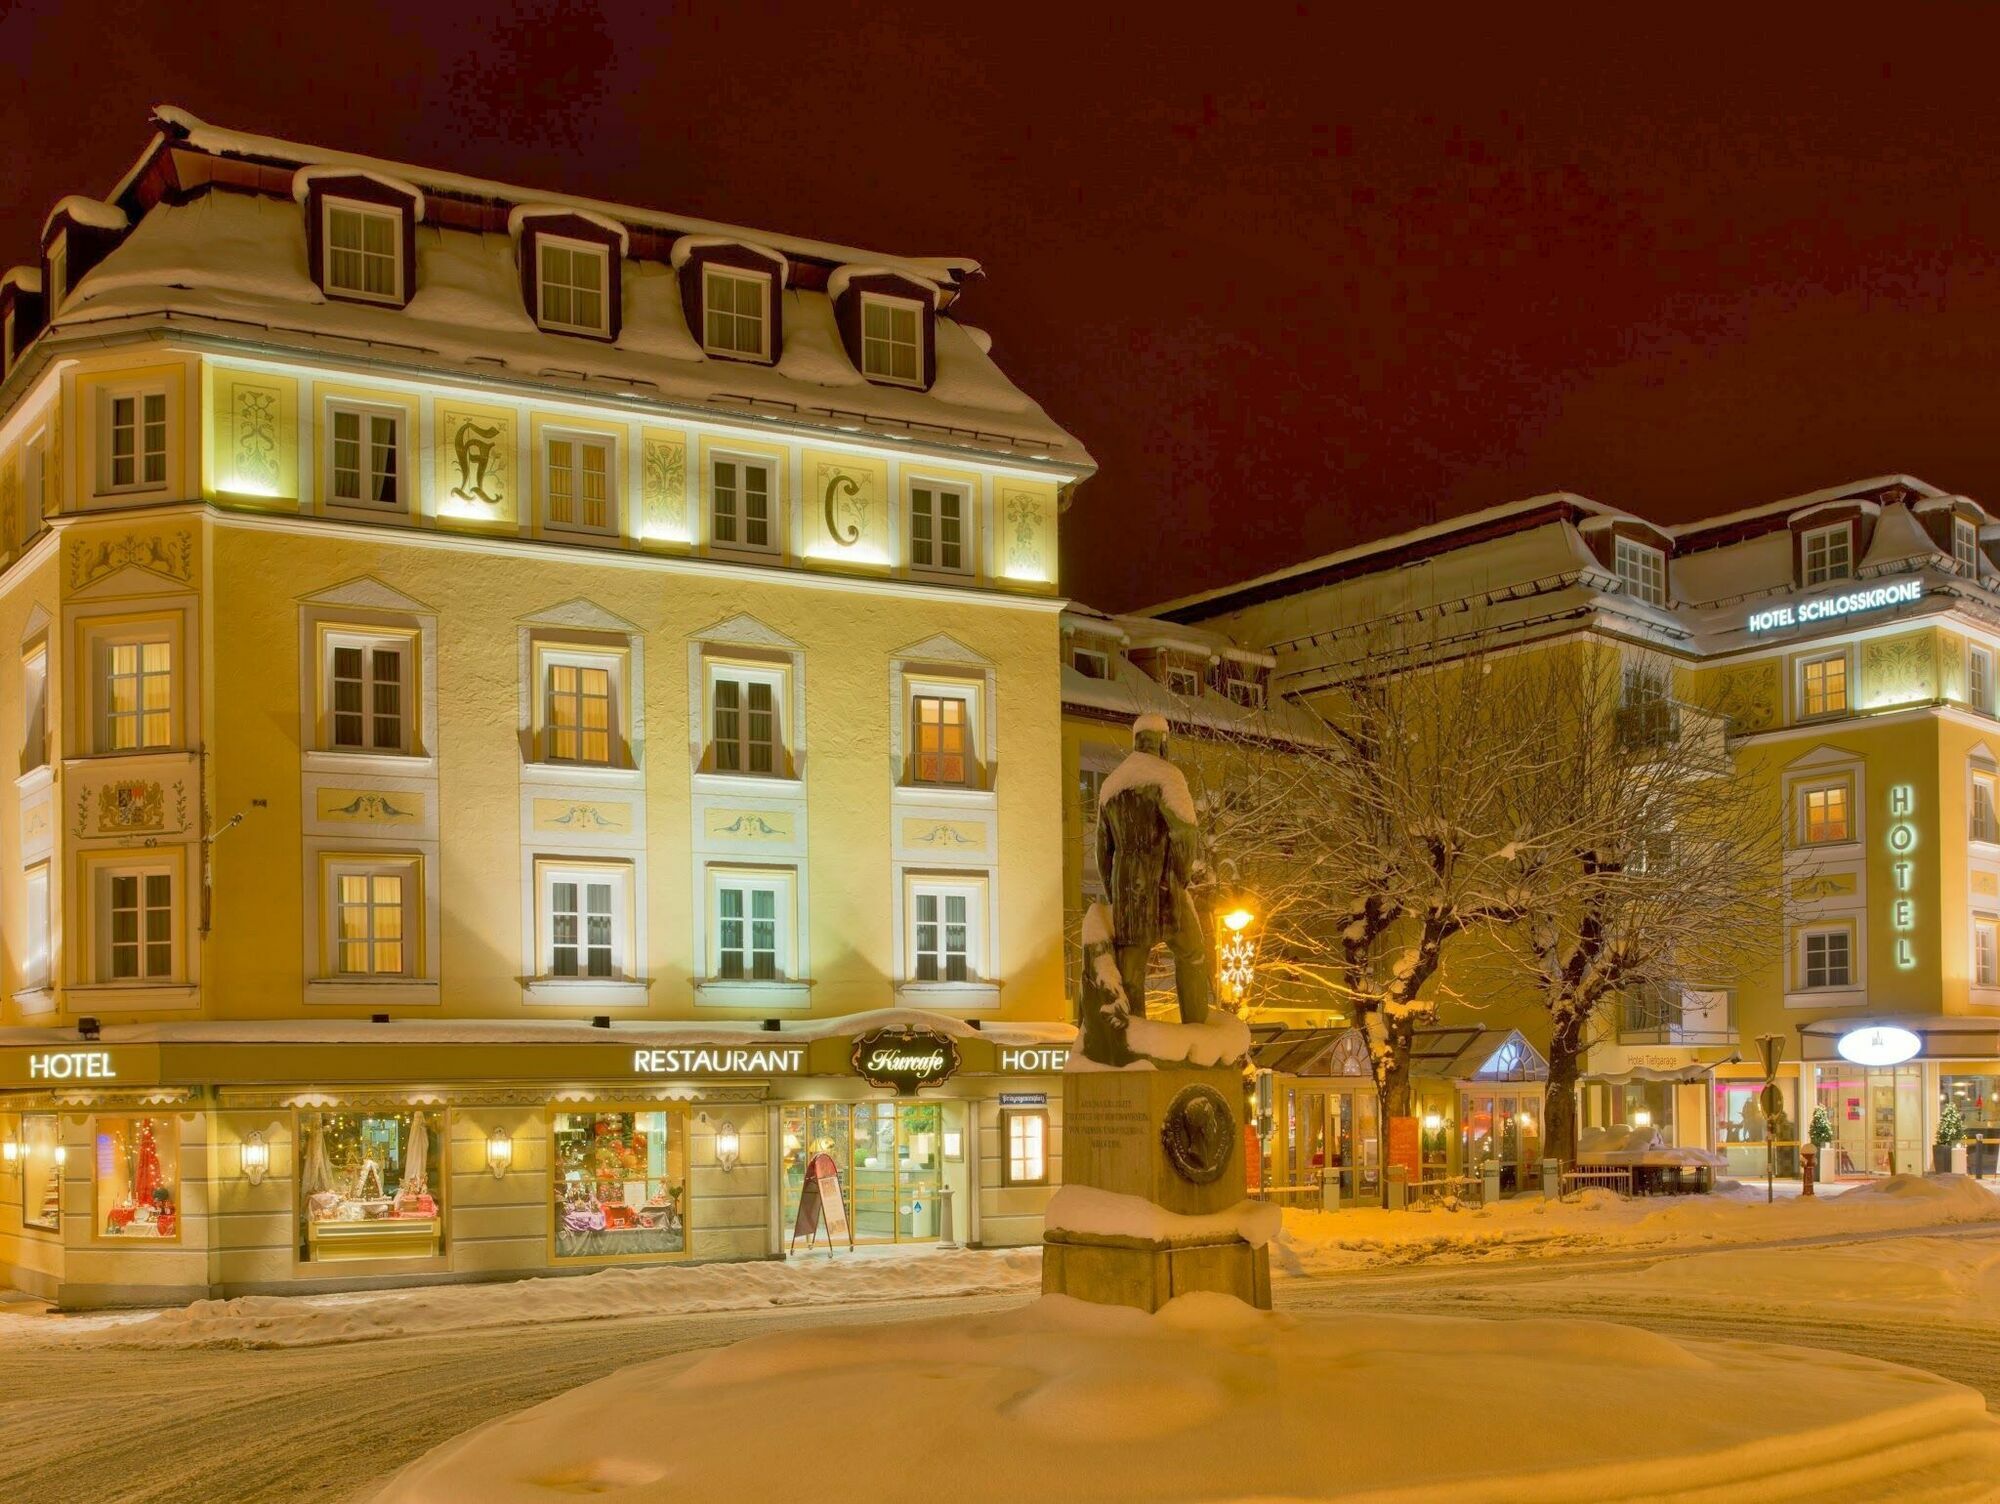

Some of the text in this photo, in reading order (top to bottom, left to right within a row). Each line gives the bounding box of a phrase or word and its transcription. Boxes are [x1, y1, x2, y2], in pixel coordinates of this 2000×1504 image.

[1750, 580, 1921, 632] HOTEL SCHLOSSKRONE
[1890, 785, 1913, 966] HOTEL
[30, 1052, 117, 1079] HOTEL
[633, 1049, 804, 1072] RESTAURANT
[867, 1048, 944, 1078] Kurcafe
[1627, 1054, 1678, 1068] Hotel Tiefgarage
